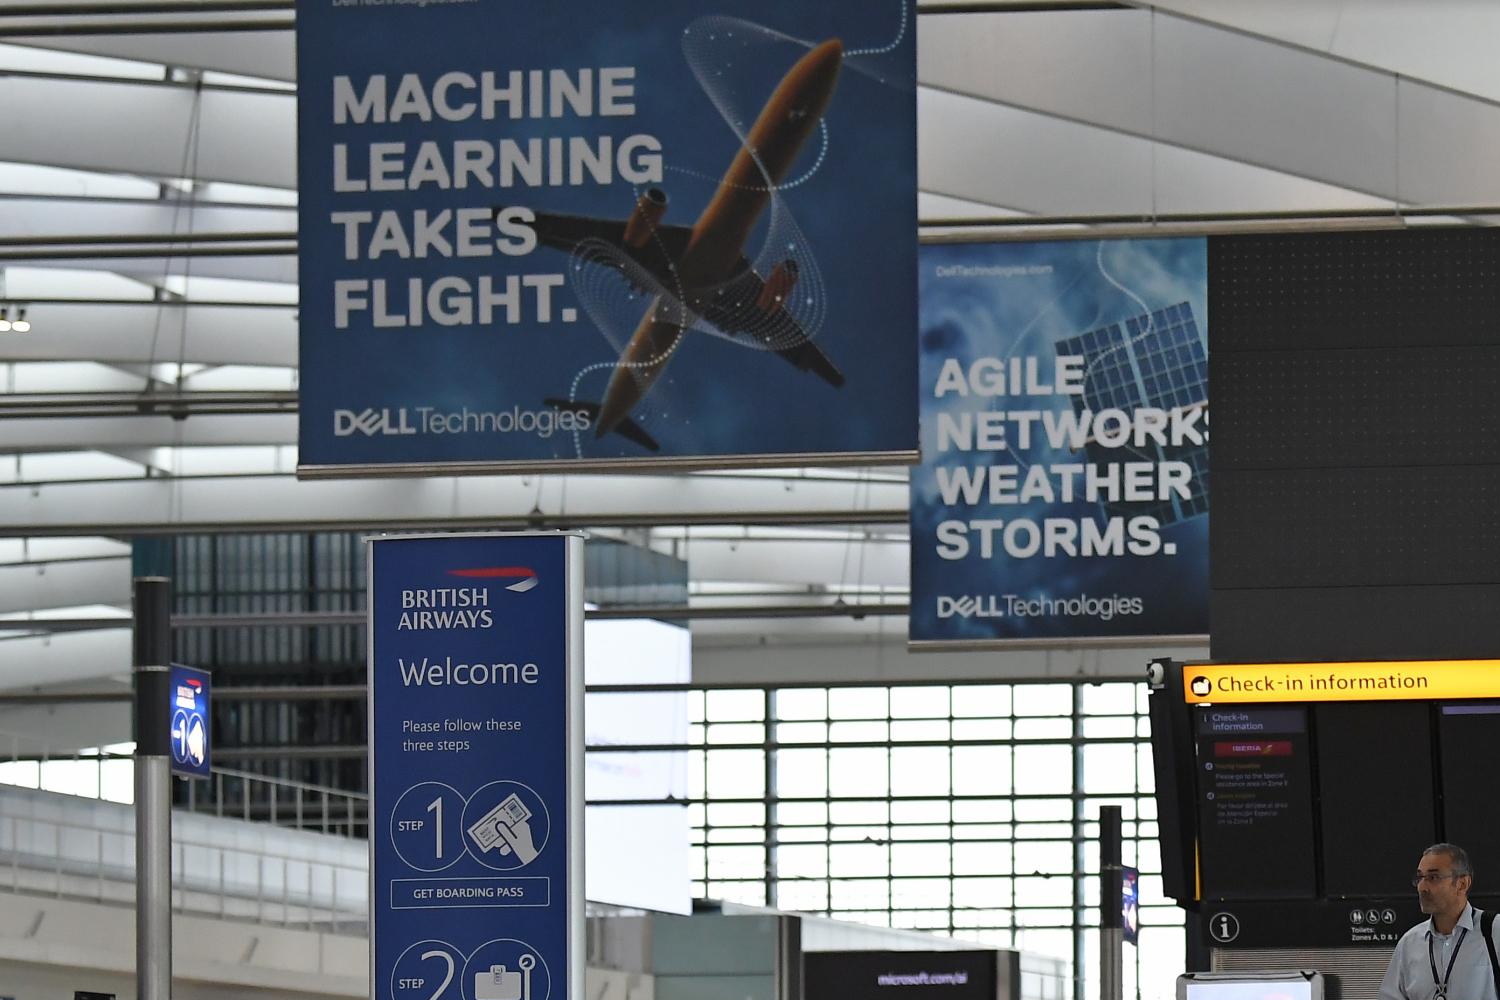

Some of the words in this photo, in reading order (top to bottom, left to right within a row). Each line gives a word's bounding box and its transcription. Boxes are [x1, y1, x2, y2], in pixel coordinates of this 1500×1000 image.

[333, 67, 637, 124] MACHINE
[333, 134, 663, 193] LEARNING
[331, 207, 537, 260] TAKES
[334, 274, 577, 329] FLIGHT.
[935, 356, 1085, 398] AGILE
[334, 409, 415, 437] DELL
[416, 406, 590, 438] Technologies
[936, 461, 1193, 506] WEATHER
[936, 516, 1177, 560] STORMS.
[402, 588, 488, 609] BRITISH
[937, 596, 1003, 618] DELL
[1003, 594, 1143, 621] Technologies
[398, 610, 493, 630] AIRWAYS
[399, 657, 539, 687] Welcome
[1218, 675, 1303, 693] Check-in
[1310, 673, 1428, 691] information
[402, 719, 440, 733] Please
[444, 718, 482, 732] follow
[486, 717, 522, 732] these
[1212, 713, 1249, 722] Check-in
[1212, 722, 1263, 731] information
[403, 738, 434, 752] three
[437, 739, 470, 753] steps
[398, 821, 424, 831] STEP
[427, 796, 442, 859] 1
[413, 888, 433, 899] GET
[436, 887, 494, 899] BOARDING
[497, 886, 524, 898] PASS
[399, 978, 424, 989] STEP
